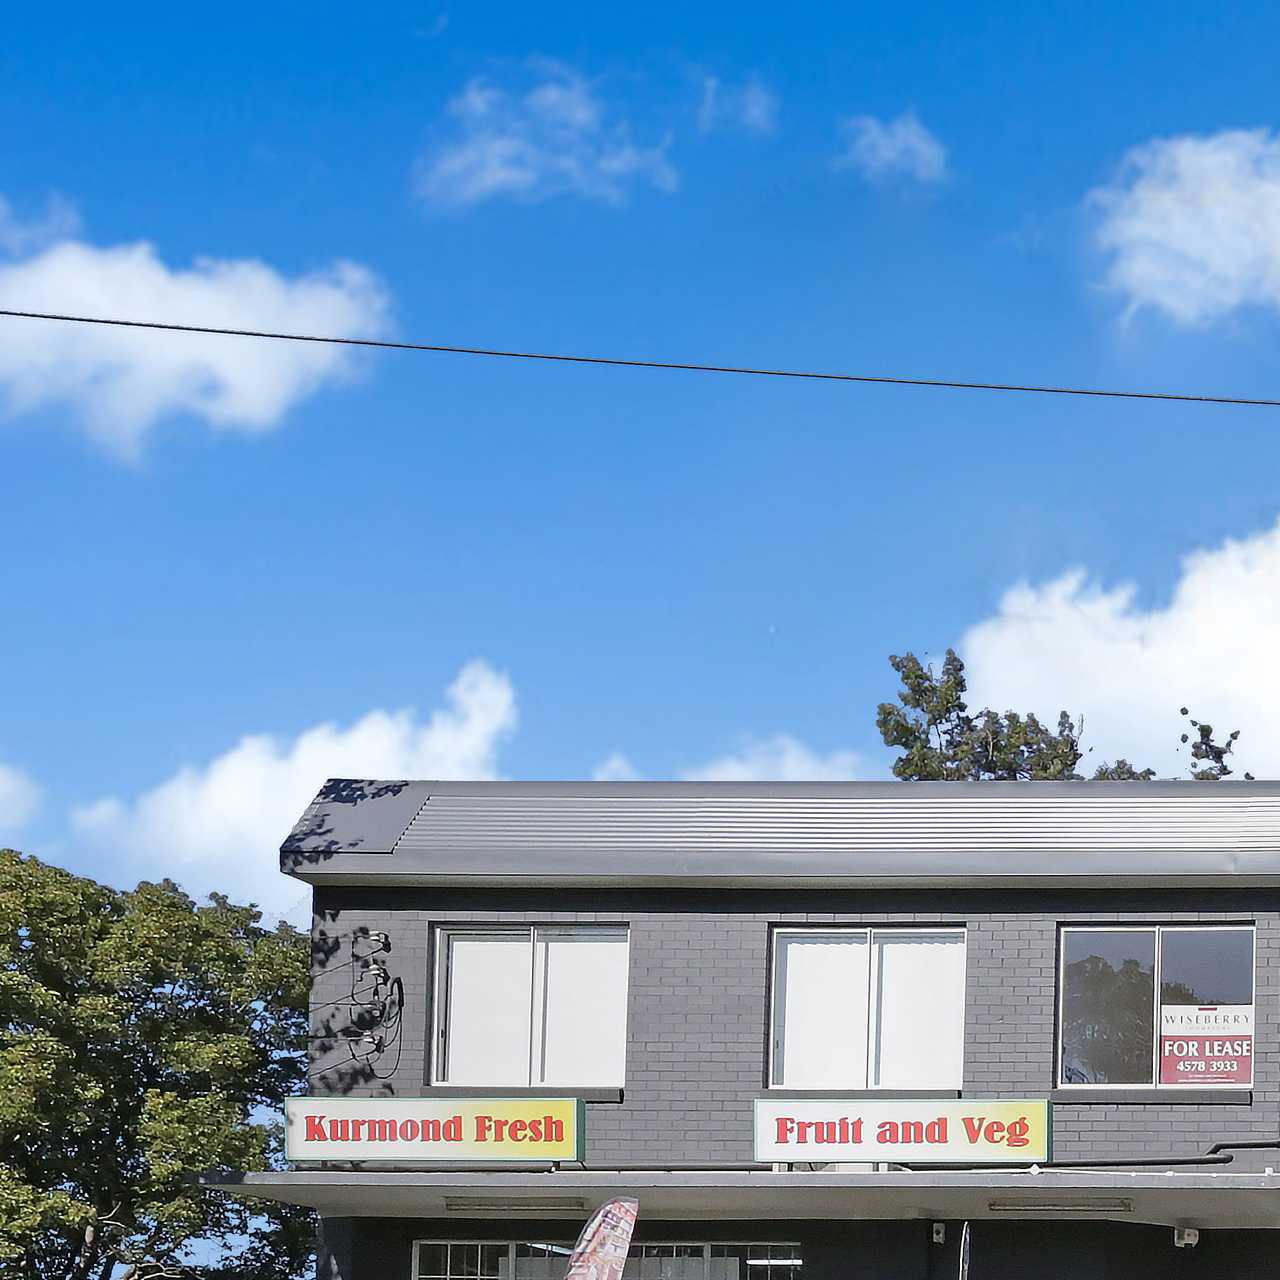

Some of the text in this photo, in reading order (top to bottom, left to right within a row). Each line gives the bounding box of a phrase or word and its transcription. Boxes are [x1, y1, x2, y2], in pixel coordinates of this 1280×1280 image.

[1164, 1015, 1250, 1024] WISEBERRY
[1164, 1040, 1251, 1056] FOR LEASE
[1176, 1061, 1238, 1072] 4578 3933
[304, 1115, 564, 1143] Kurmond Fresh
[775, 1117, 1030, 1147] Fruit and Veg
